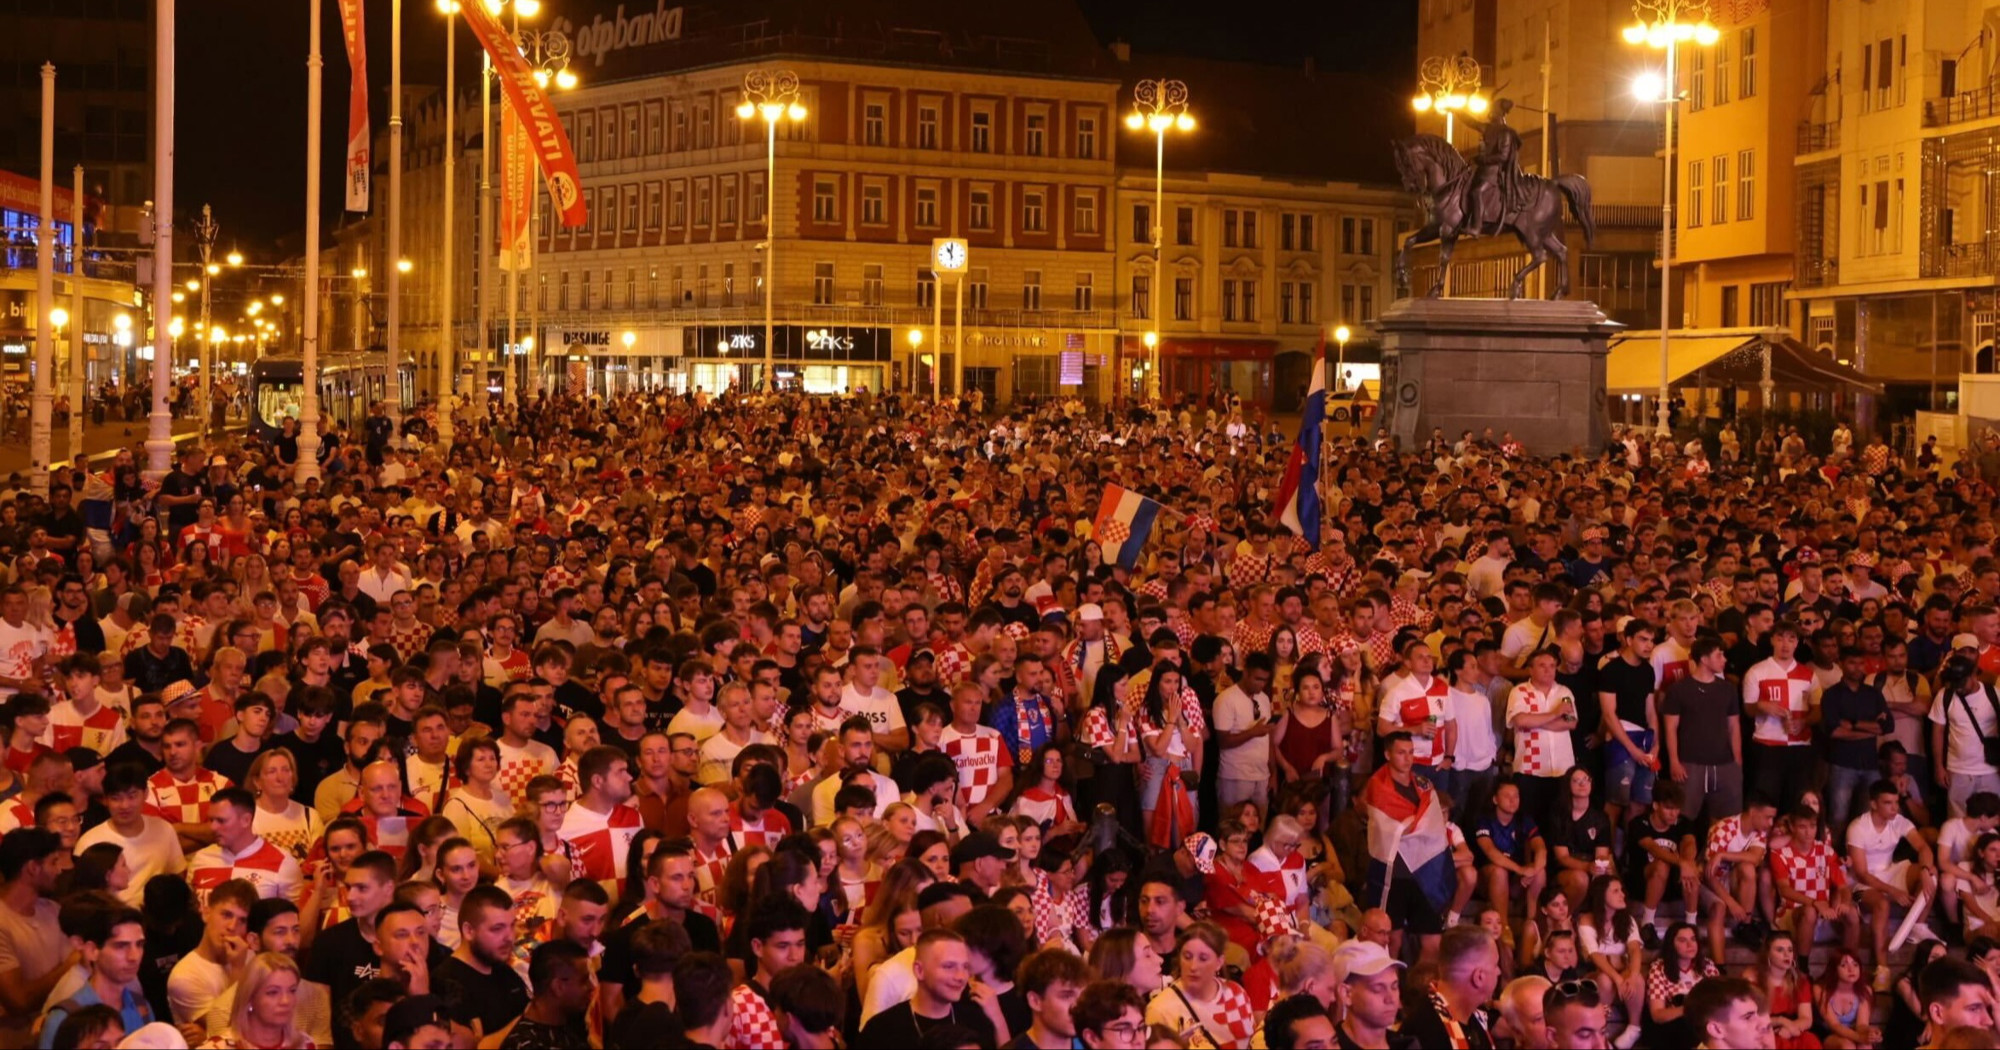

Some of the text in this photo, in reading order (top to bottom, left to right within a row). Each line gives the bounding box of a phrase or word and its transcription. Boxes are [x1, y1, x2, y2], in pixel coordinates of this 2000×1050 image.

[577, 0, 683, 67] otpbanka
[512, 71, 563, 160] HRVATI
[563, 331, 611, 346] DESSANGE
[730, 334, 756, 349] ZAKS
[810, 335, 854, 350] ZAKS
[1767, 685, 1781, 702] 10
